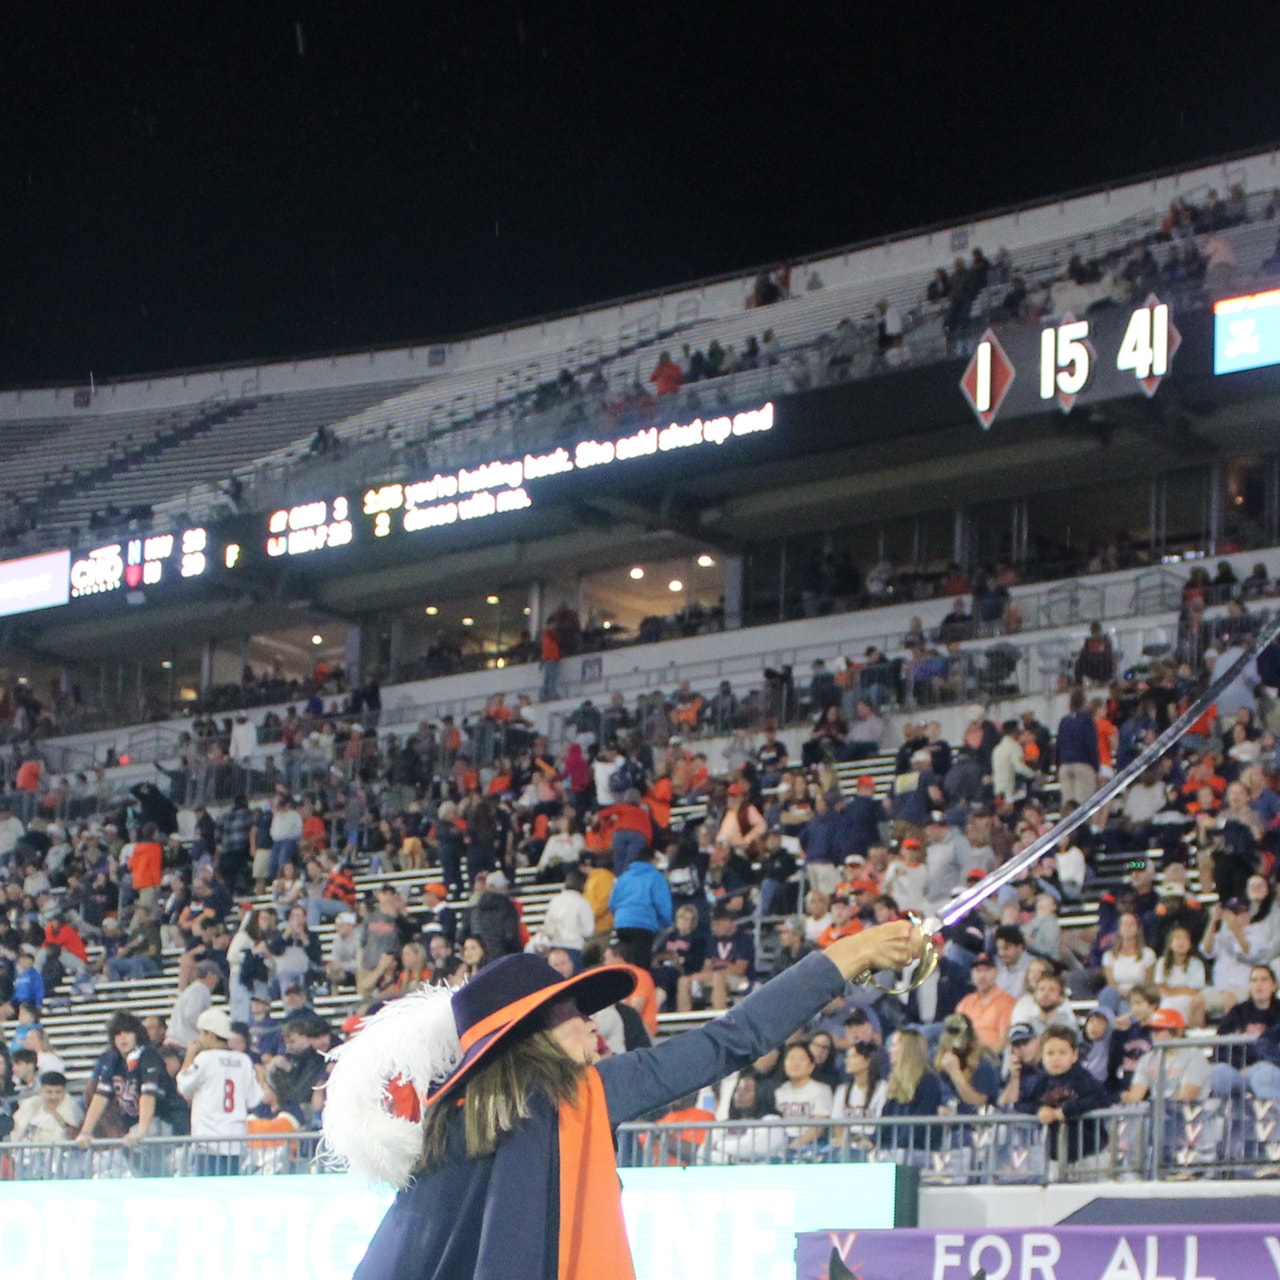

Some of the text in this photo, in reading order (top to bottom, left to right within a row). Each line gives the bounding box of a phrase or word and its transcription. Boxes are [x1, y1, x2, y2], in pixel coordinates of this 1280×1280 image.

[1040, 320, 1090, 400] 15
[1117, 303, 1168, 379] 41
[703, 416, 732, 444] up
[223, 1079, 235, 1113] 8
